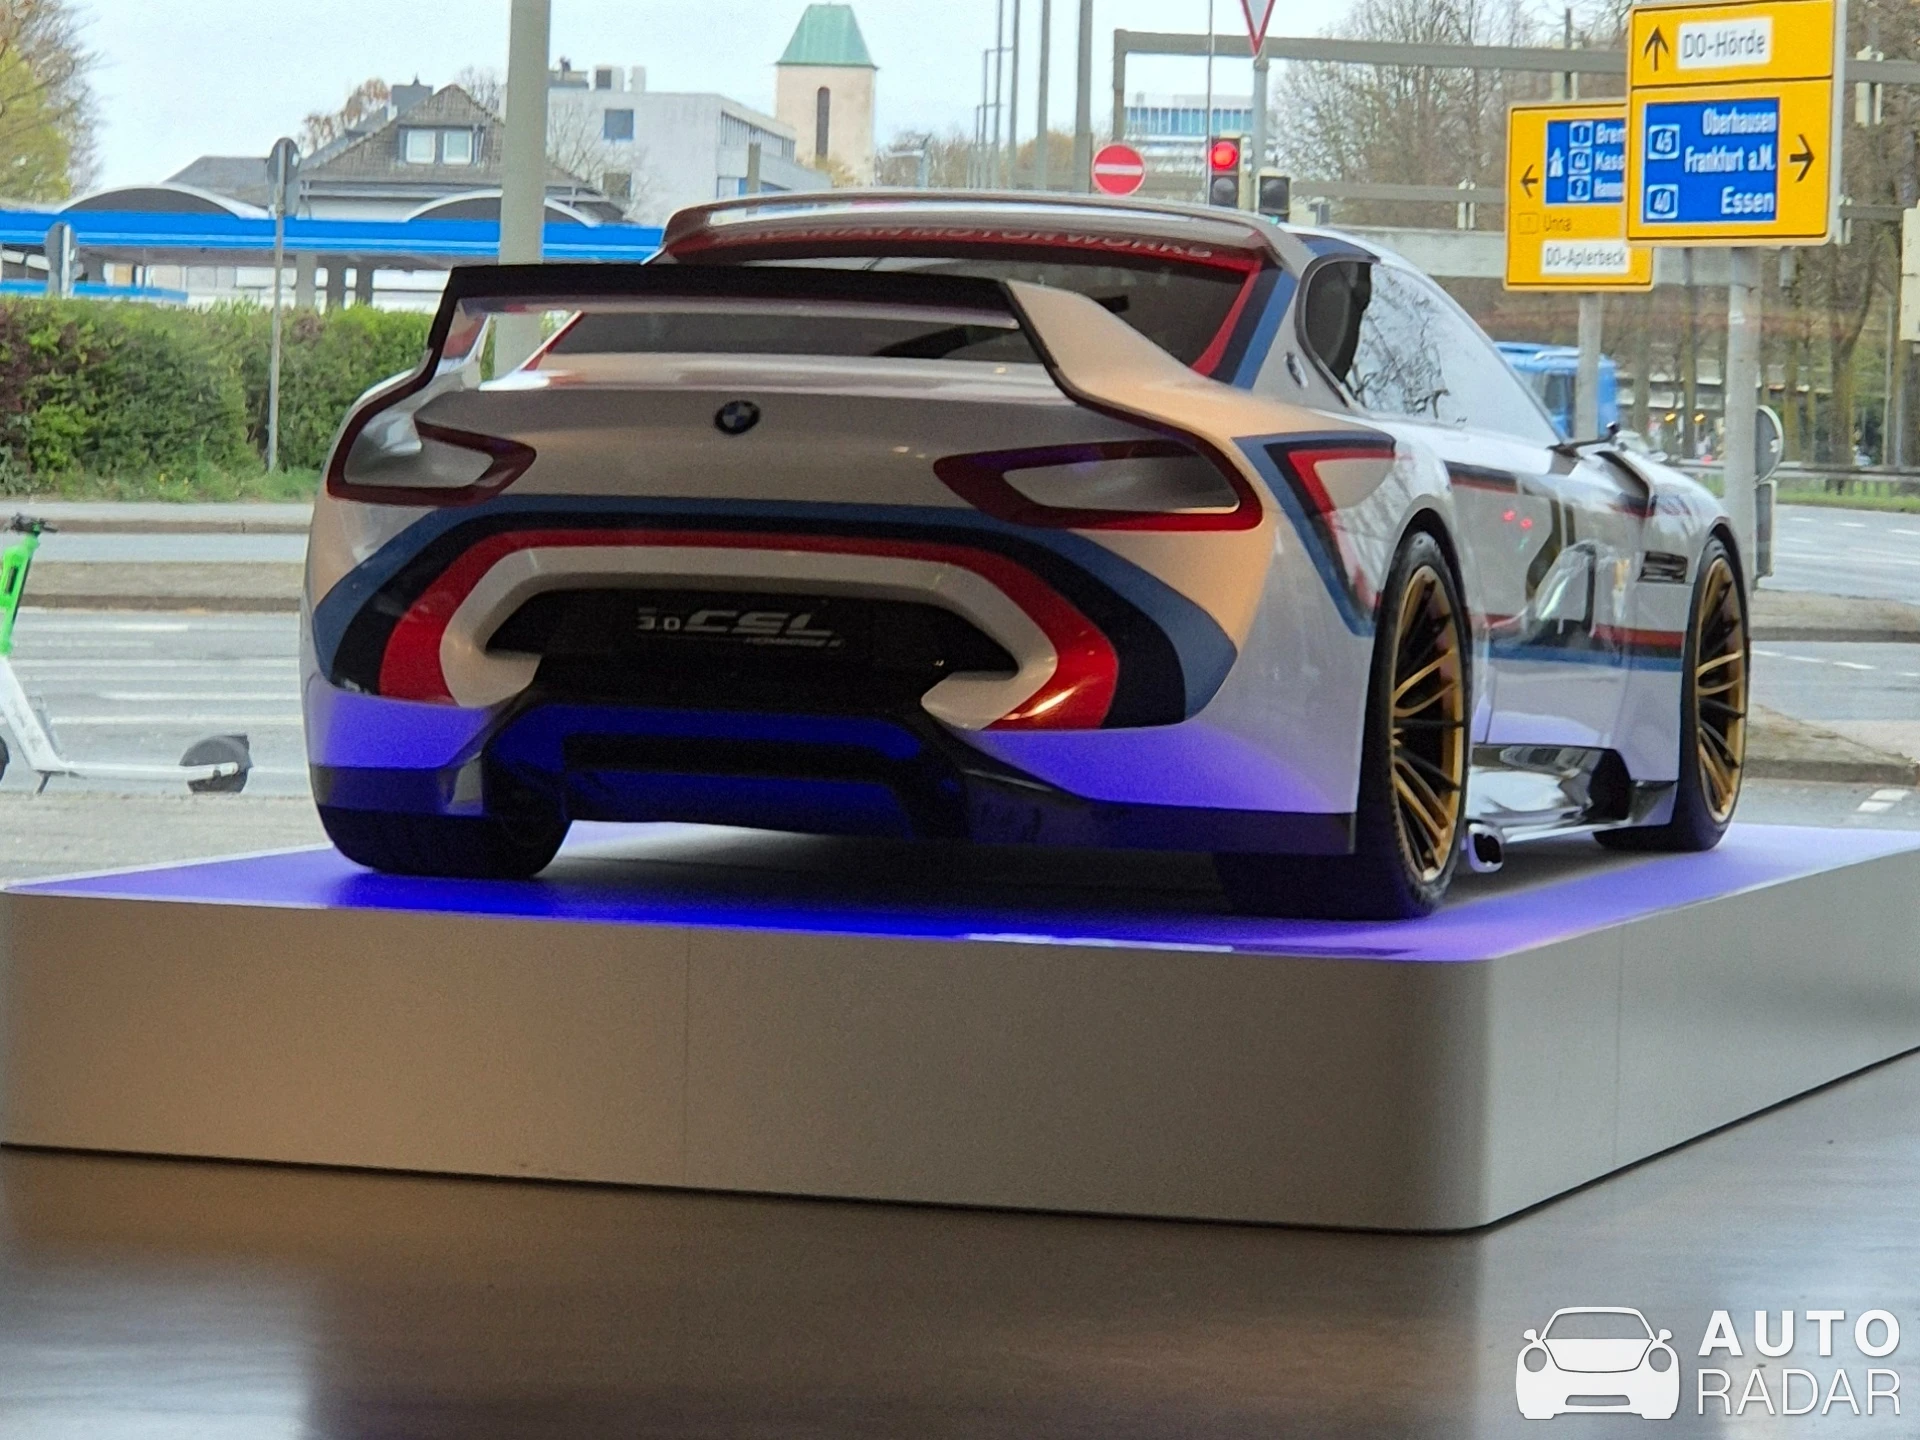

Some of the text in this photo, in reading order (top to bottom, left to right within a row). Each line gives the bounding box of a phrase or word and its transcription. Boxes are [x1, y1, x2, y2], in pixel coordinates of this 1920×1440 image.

[1683, 28, 1765, 58] DO-Hörde
[1702, 106, 1776, 135] Oberhausen
[1655, 131, 1673, 151] 45
[1684, 145, 1744, 173] Frankfurt
[1654, 186, 1775, 214] 40 Essen
[1545, 246, 1626, 271] DO-Aplerbeck
